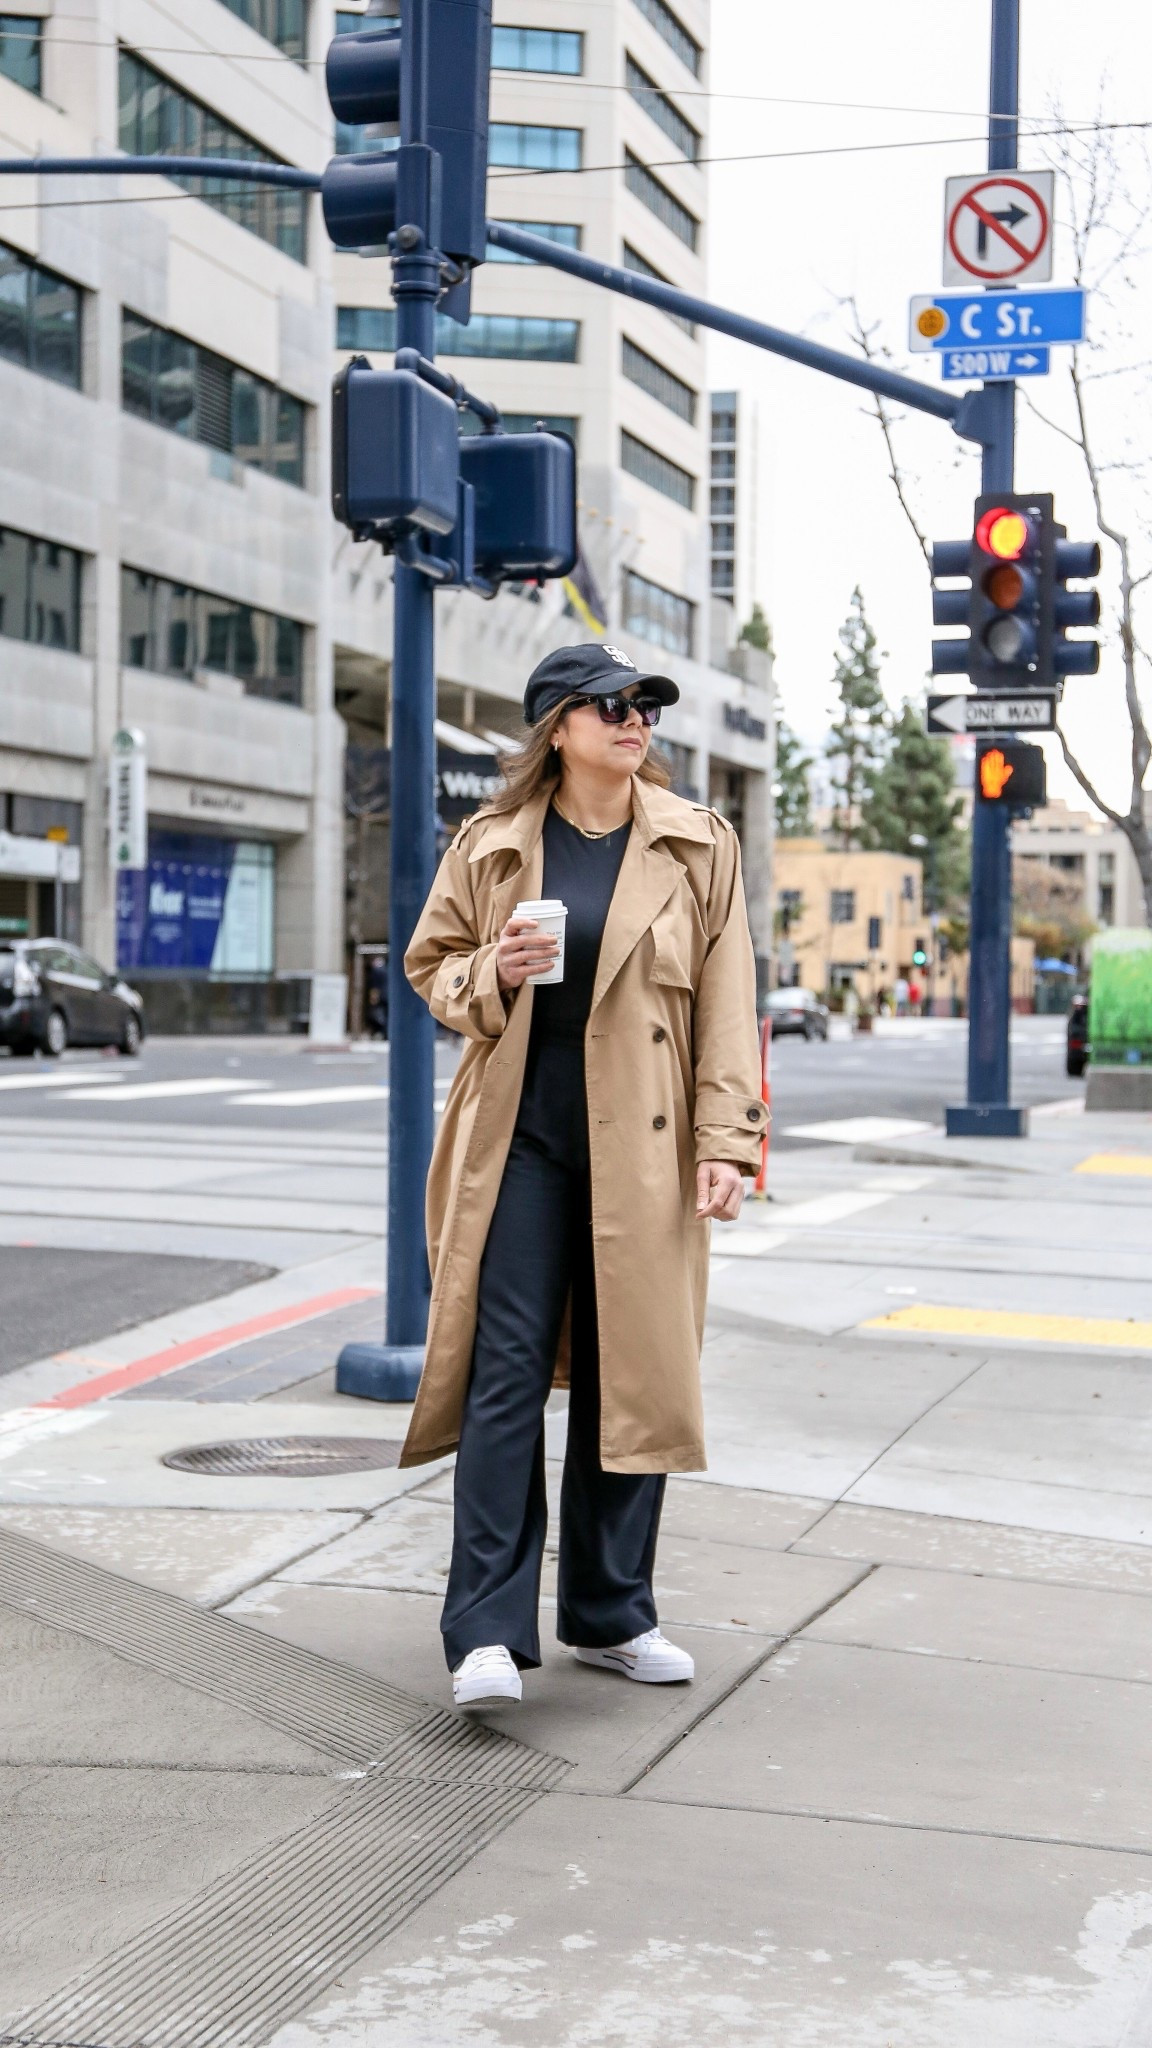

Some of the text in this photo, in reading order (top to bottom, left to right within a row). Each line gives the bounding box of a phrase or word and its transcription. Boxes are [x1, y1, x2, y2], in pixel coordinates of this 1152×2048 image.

[960, 302, 1043, 339] C ST.
[949, 351, 1012, 377] 500W
[966, 703, 1042, 721] ONE WAY
